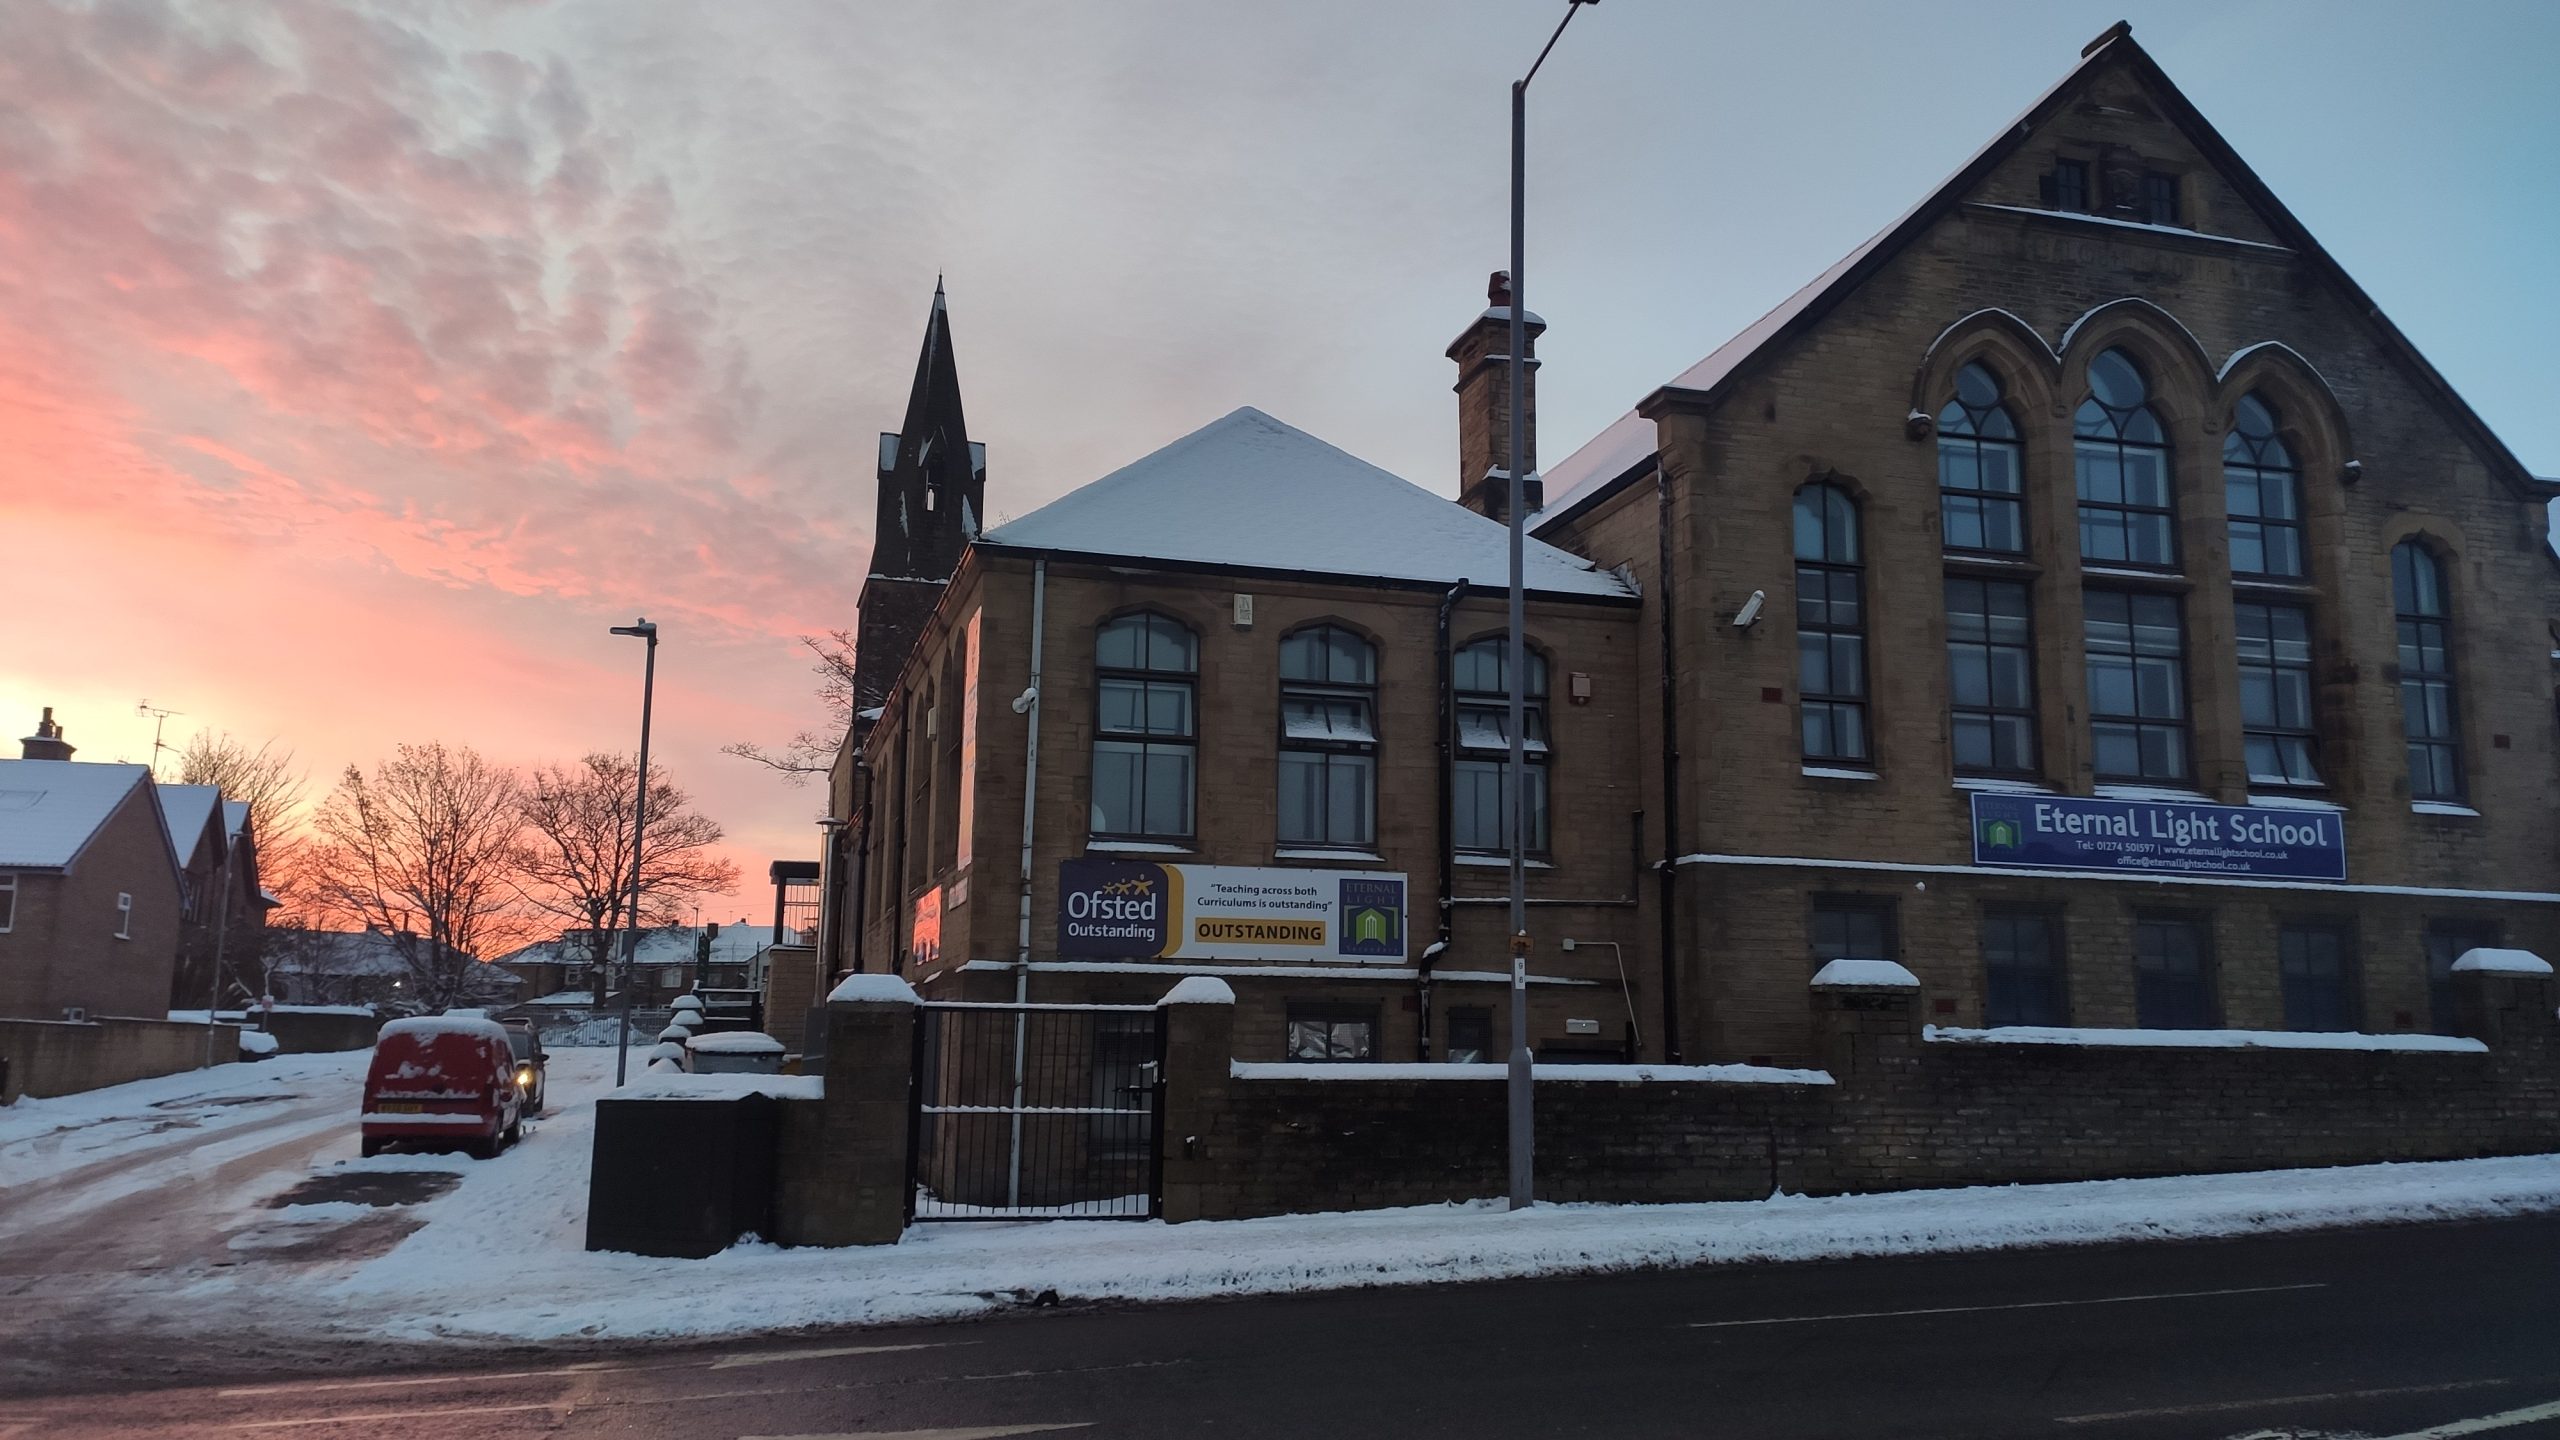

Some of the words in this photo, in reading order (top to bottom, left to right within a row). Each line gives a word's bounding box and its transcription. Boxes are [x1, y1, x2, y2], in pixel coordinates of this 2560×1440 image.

[2035, 803, 2139, 837] Eternal
[2150, 809, 2220, 846] Light
[2231, 814, 2327, 847] School
[2076, 840, 2094, 851] Tel:
[2097, 841, 2123, 852] 01274
[2125, 843, 2155, 853] 501597
[2164, 846, 2288, 859] www.eternallightschool.co.uk
[2117, 856, 2251, 871] office@eternallightschool.co.uk
[1262, 887, 1292, 895] across
[1295, 885, 1317, 896] both
[1346, 882, 1396, 894] ETERNAL
[1068, 891, 1156, 920] Ofsted
[1198, 897, 1256, 908] Curriculums
[1259, 899, 1266, 908] is
[1068, 923, 1155, 942] Outstanding
[1199, 922, 1322, 940] OUTSTANDING
